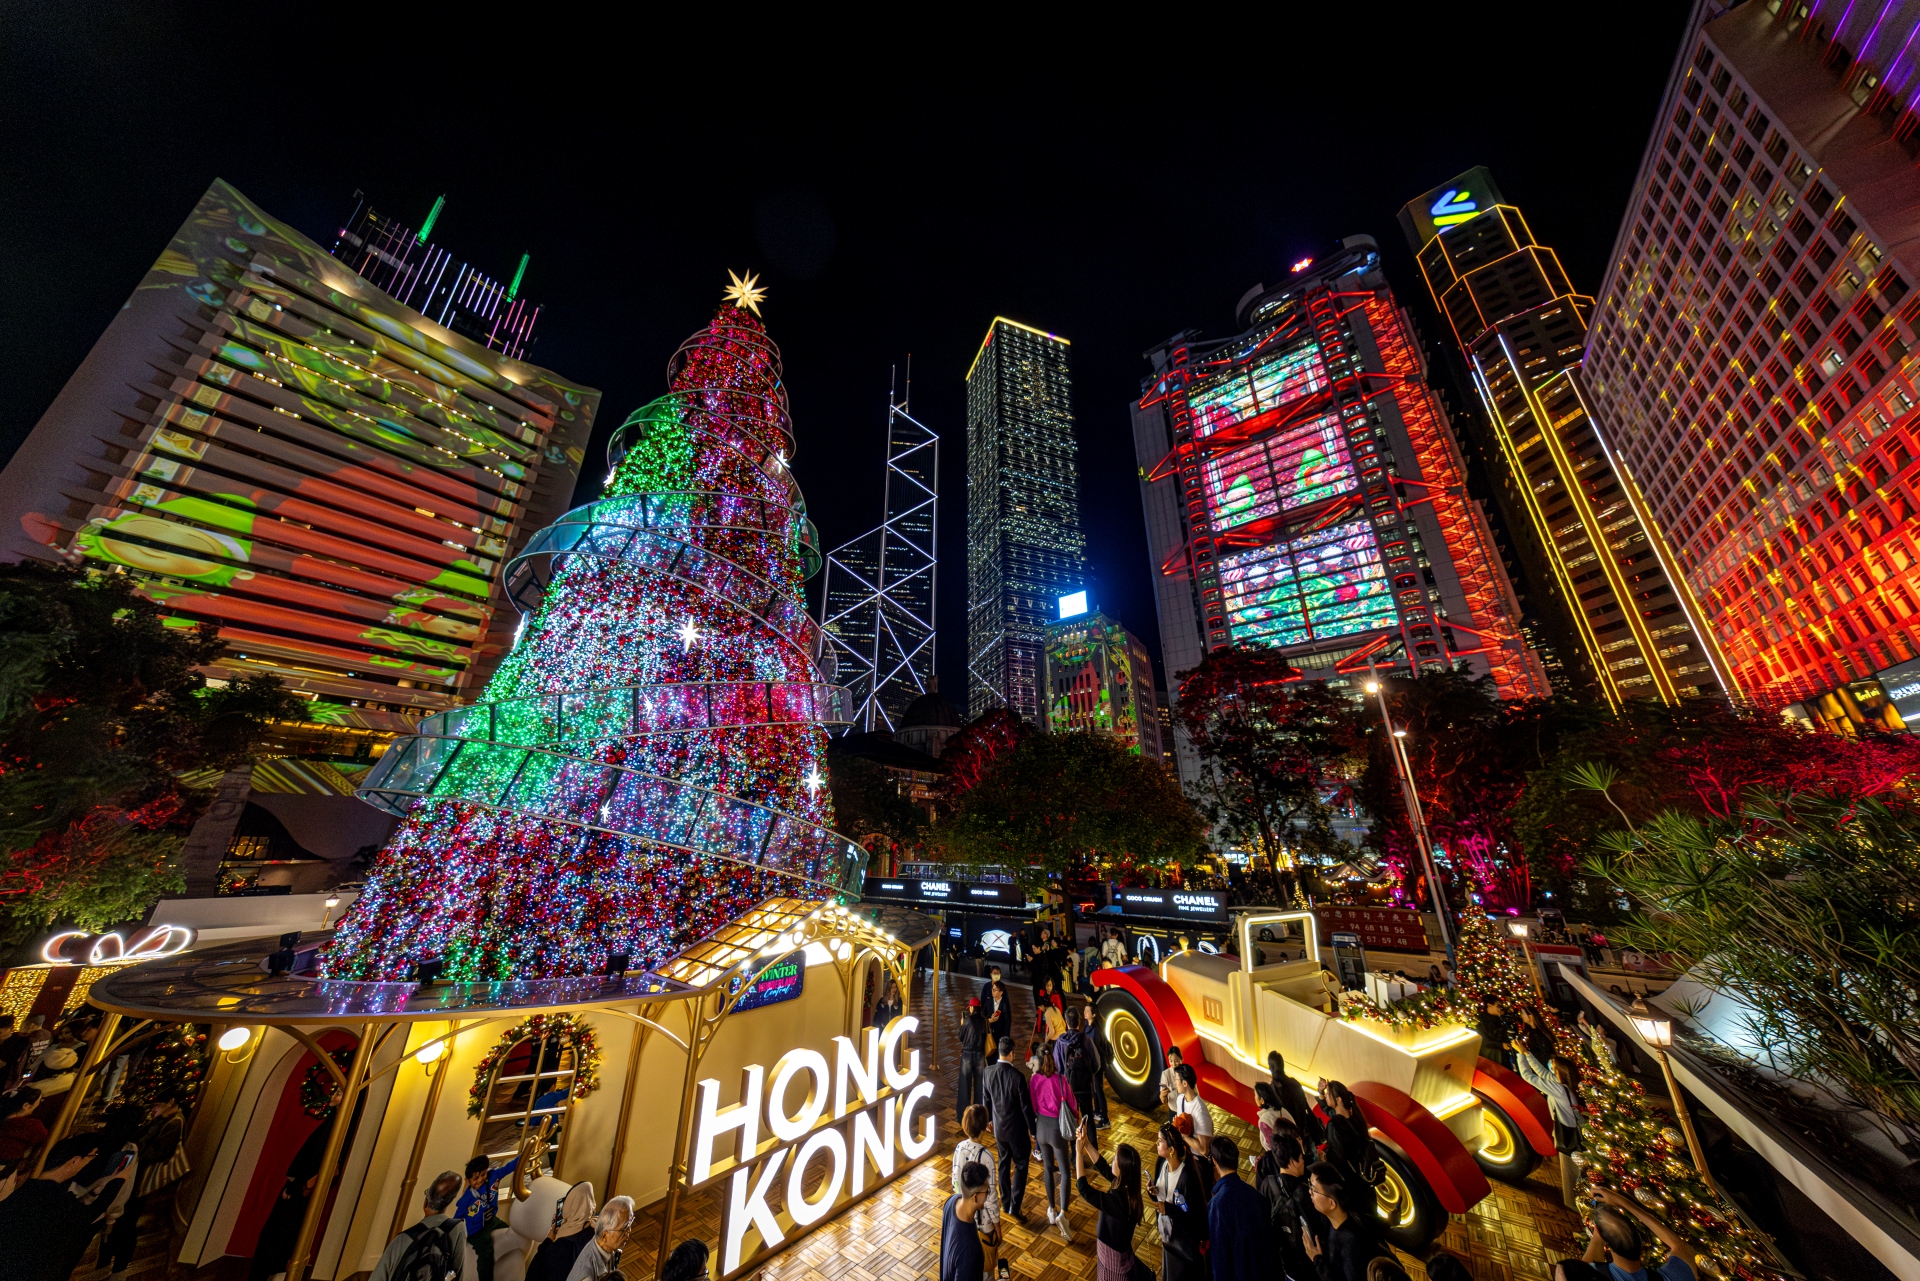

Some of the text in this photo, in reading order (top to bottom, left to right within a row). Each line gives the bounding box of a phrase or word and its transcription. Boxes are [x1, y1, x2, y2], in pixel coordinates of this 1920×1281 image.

[921, 881, 951, 892] CHANEL
[1172, 894, 1219, 907] CHANEL
[760, 964, 798, 982] WINTER
[689, 1015, 920, 1186] HONG
[722, 1081, 935, 1276] KONG
